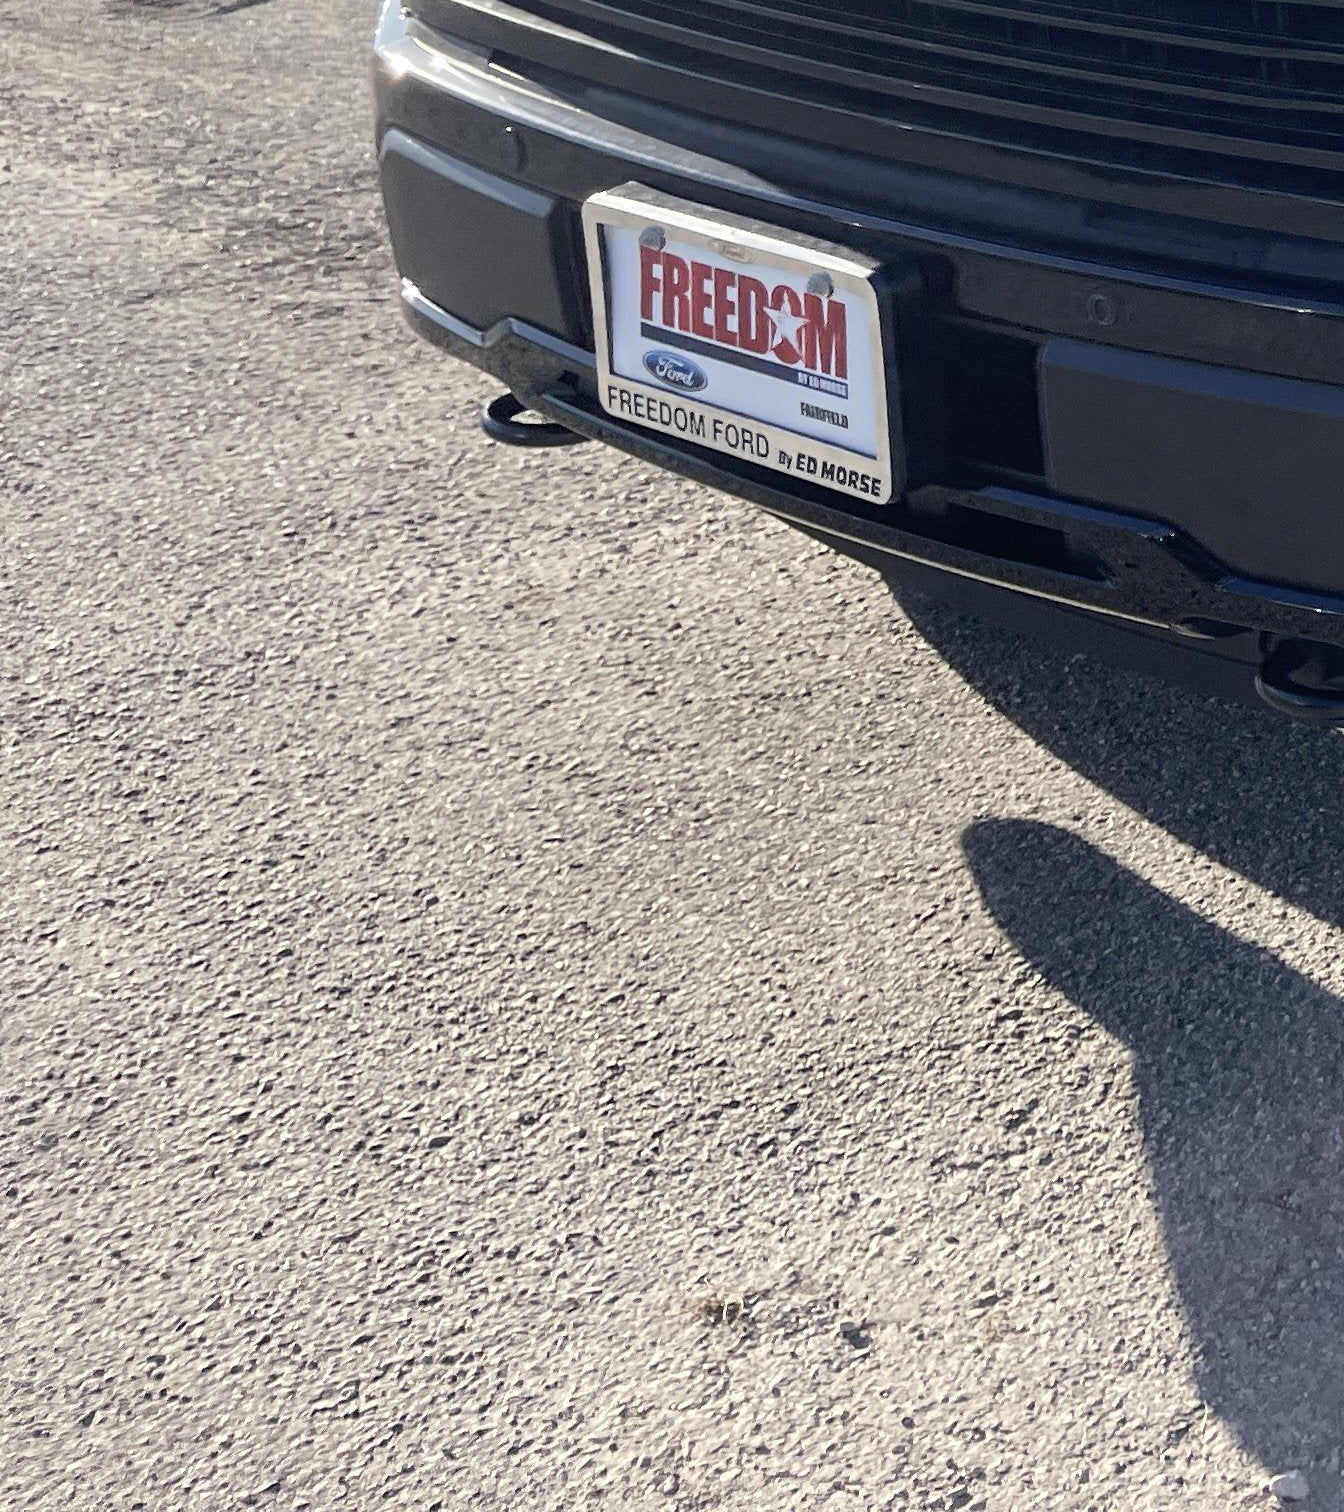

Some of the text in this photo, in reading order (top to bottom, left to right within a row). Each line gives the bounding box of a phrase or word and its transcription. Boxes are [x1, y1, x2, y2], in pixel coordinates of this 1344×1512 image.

[639, 245, 848, 380] FREEDOM
[655, 356, 696, 387] Ford
[607, 385, 706, 439] FREEDOM
[713, 418, 770, 459] FORD
[796, 452, 818, 475] ED
[821, 460, 882, 497] MORSE
